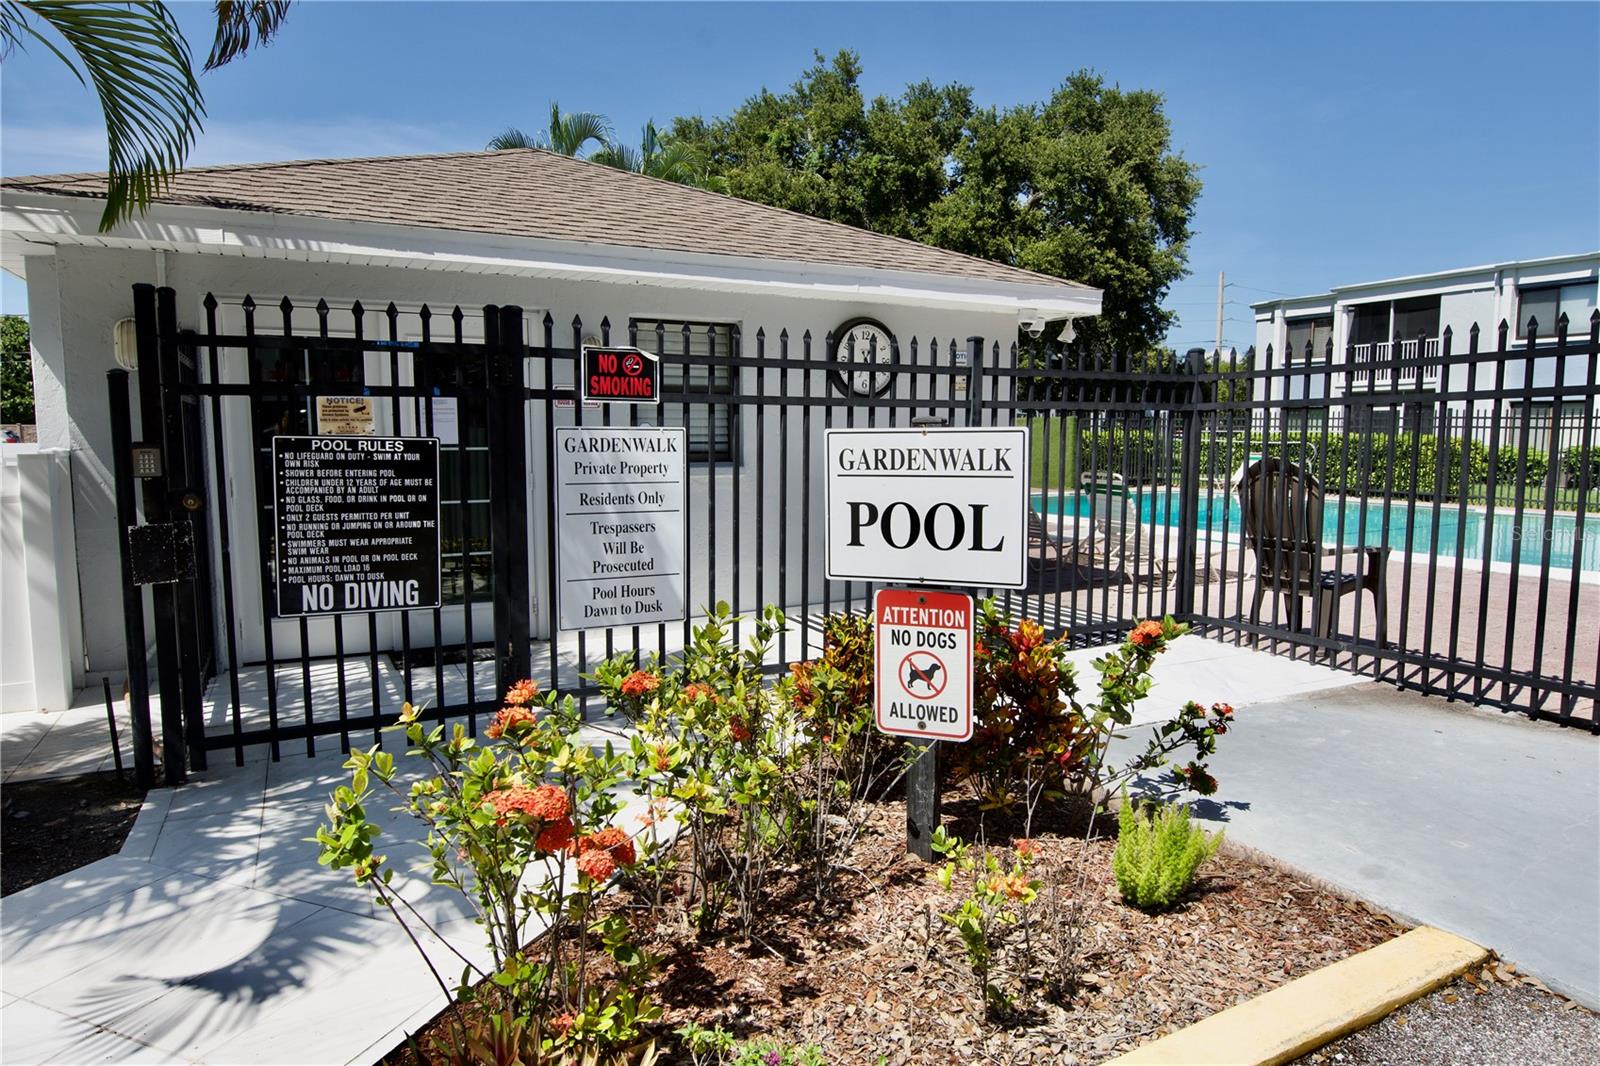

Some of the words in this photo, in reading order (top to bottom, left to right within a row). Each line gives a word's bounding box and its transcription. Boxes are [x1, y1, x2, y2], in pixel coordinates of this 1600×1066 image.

[862, 330, 870, 340] 12
[598, 354, 617, 374] NO
[590, 376, 652, 396] SMOKING
[311, 440, 352, 451] POOL
[358, 441, 404, 451] RULES
[564, 437, 678, 453] GARDENWALK
[838, 448, 1012, 472] GARDENWALK
[574, 461, 616, 474] Private
[620, 461, 668, 478] Property
[580, 493, 634, 506] Residents
[638, 491, 664, 507] Only
[286, 514, 302, 522] ONLY
[313, 513, 338, 521] GUESTS
[341, 512, 378, 520] PERMITTED
[590, 522, 656, 536] Trespassers
[846, 502, 1004, 552] POOL
[288, 539, 326, 548] SWIMMERS
[329, 539, 347, 547] MUST
[350, 538, 368, 546] WEAR
[371, 537, 412, 546] APPROPRIATE
[603, 542, 626, 554] Will
[630, 540, 644, 554] Be
[300, 556, 329, 564] ANIMALS
[592, 558, 654, 574] Prosecuted
[288, 565, 322, 574] MAXIMUM
[325, 565, 341, 573] POOL
[288, 576, 305, 584] POOL
[308, 574, 332, 583] HOURS:
[302, 584, 334, 612] NO
[344, 580, 419, 609] DIVING
[592, 586, 617, 600] Pool
[621, 585, 656, 598] Hours
[584, 605, 617, 618] Dawn
[621, 602, 632, 614] to
[635, 600, 663, 614] Dusk
[882, 606, 964, 628] ATTENTION
[891, 630, 911, 646] NO
[916, 630, 956, 650] DOGS
[890, 702, 958, 724] ALLOWED
